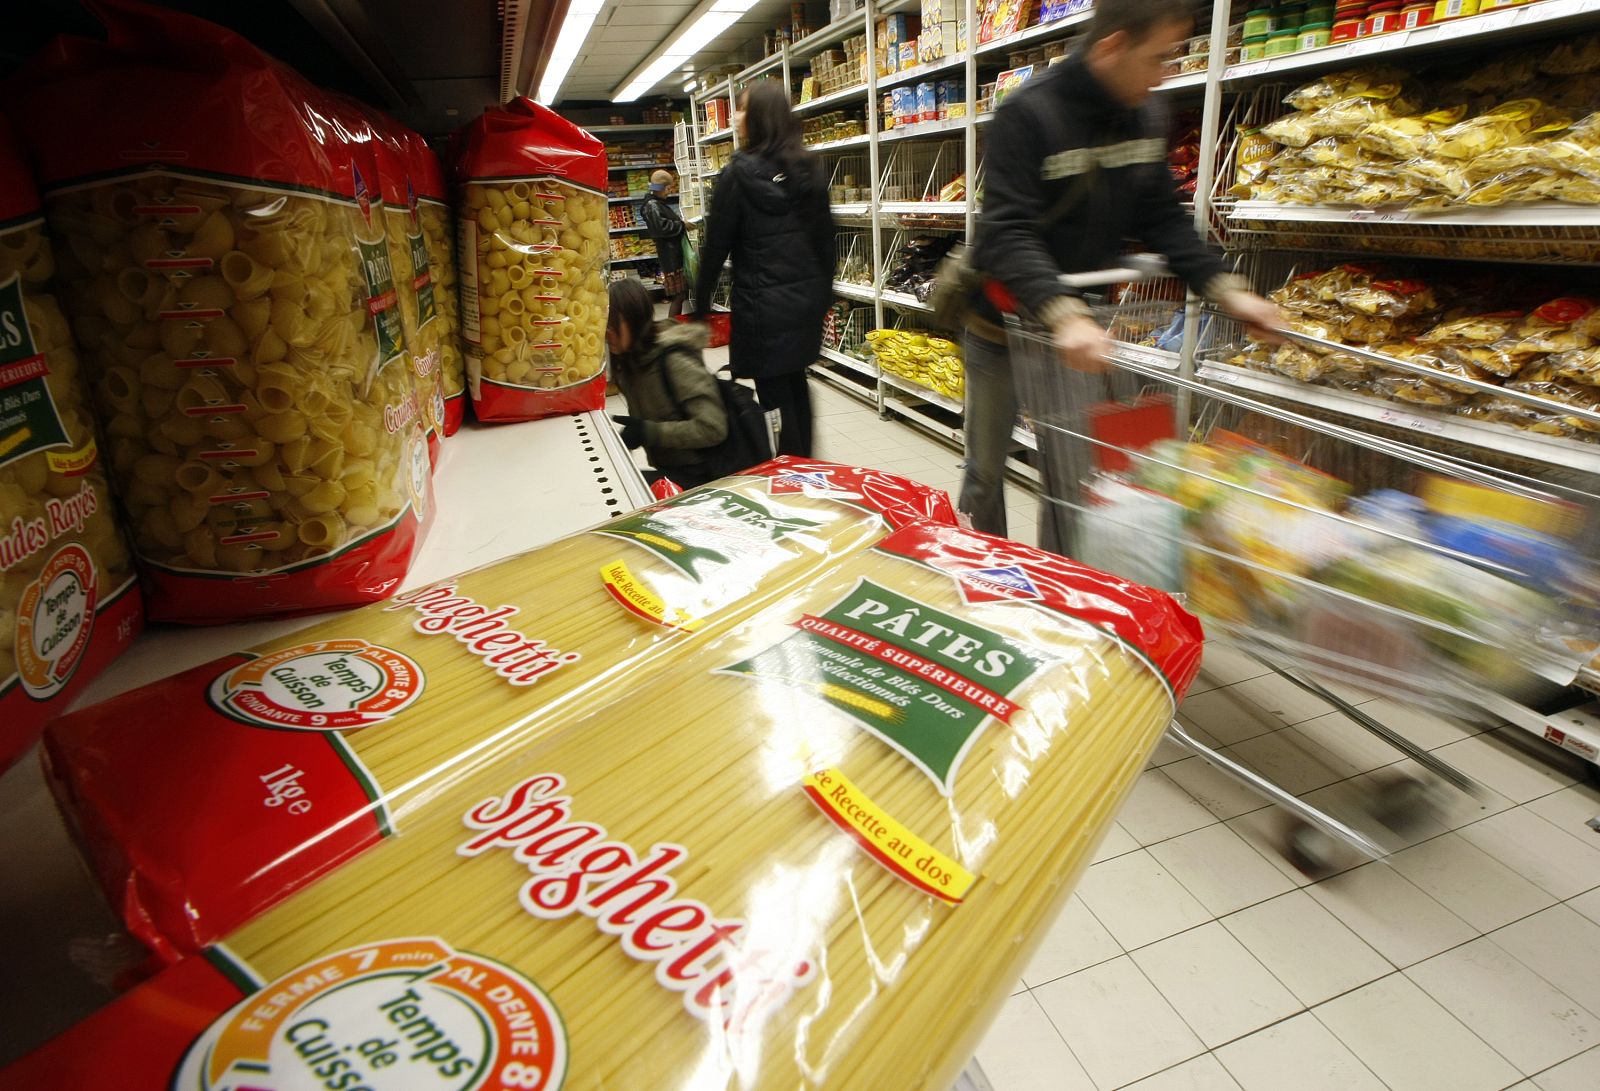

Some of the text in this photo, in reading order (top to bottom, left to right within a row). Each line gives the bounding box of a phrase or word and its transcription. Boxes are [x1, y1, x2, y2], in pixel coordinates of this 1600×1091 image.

[47, 481, 97, 537] Rayés
[43, 580, 77, 617] Temps
[609, 565, 625, 585] Idée
[622, 582, 652, 607] Recette
[648, 604, 664, 616] au
[41, 612, 81, 657] Cuisson
[56, 611, 67, 626] de
[386, 578, 580, 684] Spaghetti
[844, 598, 1015, 679] PÂTES
[247, 648, 306, 672] FERME
[311, 642, 329, 652] 7
[324, 656, 372, 694] Temps
[369, 650, 385, 662] AL
[383, 657, 411, 689] DENTE
[800, 618, 1010, 717] QUALITÉ SUPÉRIEURE
[269, 666, 326, 709] Cuisson
[309, 674, 331, 689] de
[385, 688, 409, 701] 8
[803, 640, 966, 721] Semoule de Blés Durs
[816, 659, 912, 708] Sélectionnés
[238, 692, 303, 724] FONDANTE
[309, 714, 328, 726] 9
[813, 768, 953, 888] ée Recette au dos
[239, 966, 345, 1033] FERME
[348, 948, 380, 971] 7
[378, 988, 475, 1080] Temps
[447, 966, 542, 1088] AL DENTE 8
[284, 1018, 376, 1091] Cuiss
[358, 1035, 400, 1070] de
